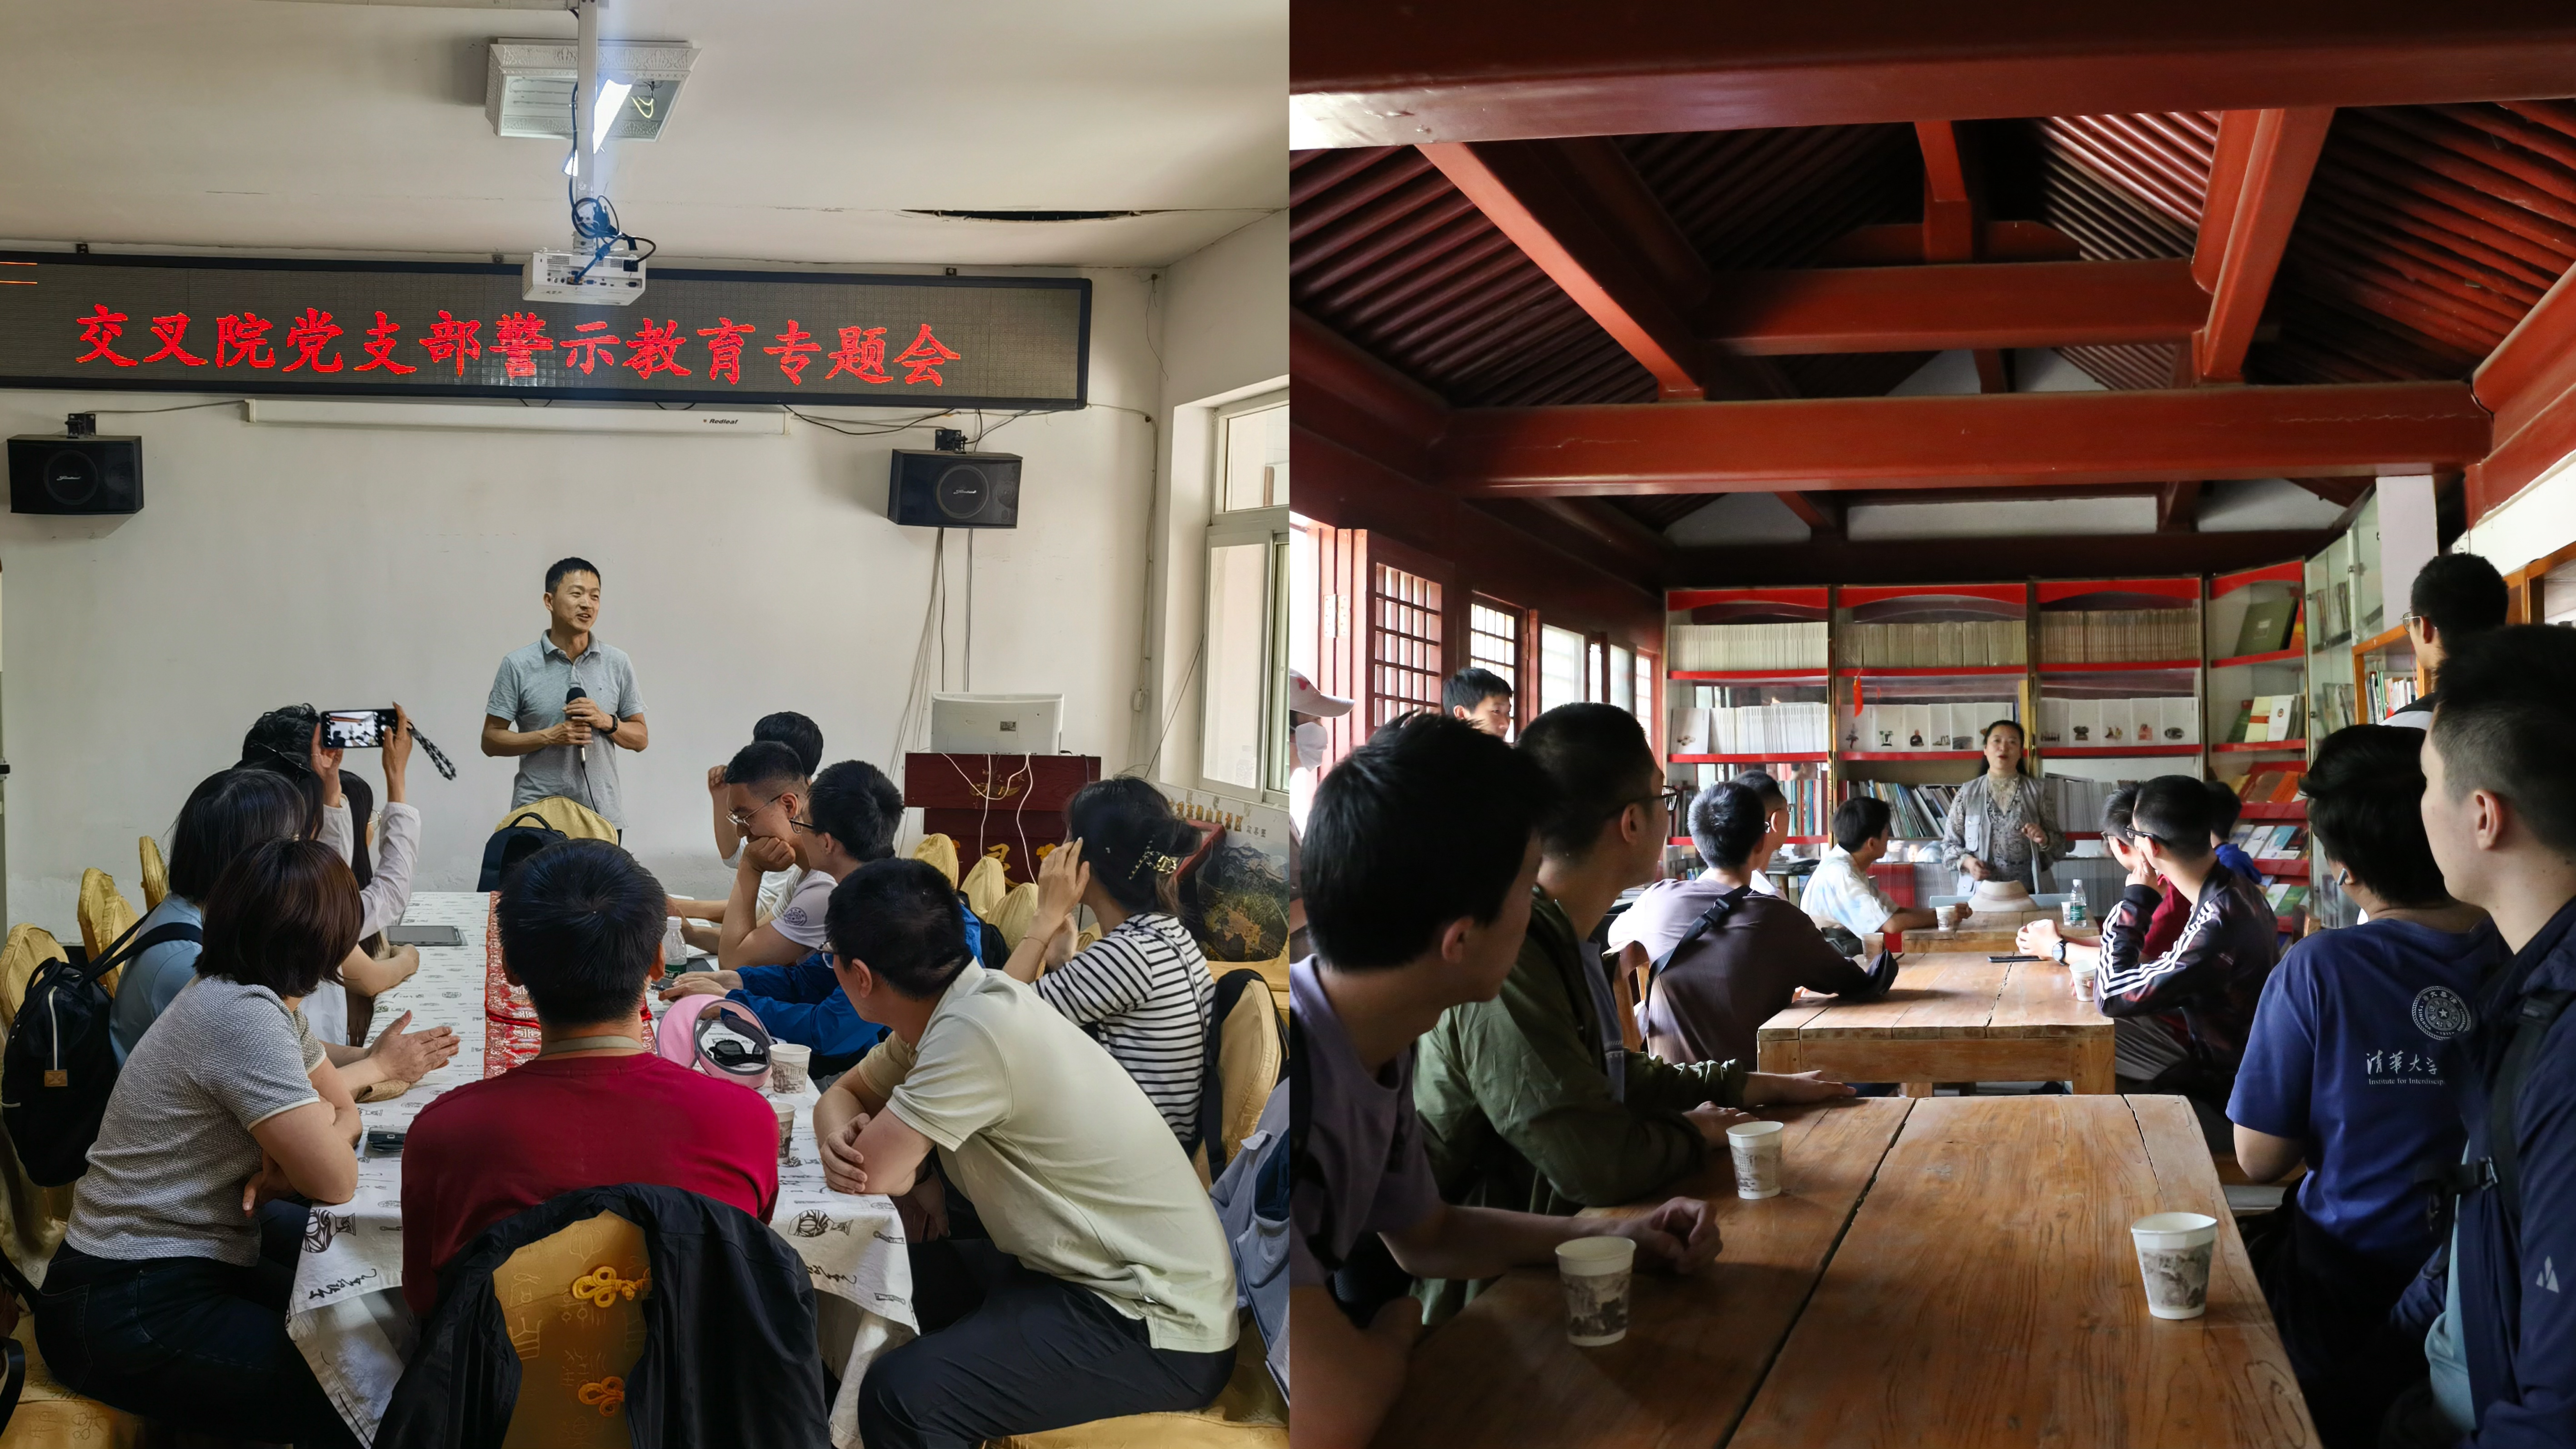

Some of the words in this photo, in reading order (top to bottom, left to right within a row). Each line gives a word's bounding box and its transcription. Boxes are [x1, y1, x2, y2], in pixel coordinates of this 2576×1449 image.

[76, 303, 960, 386] 交叉院党支部警示教育专题会
[2418, 1005, 2432, 1031] TSINGHUA
[2409, 1078, 2446, 1086] Interdiscip
